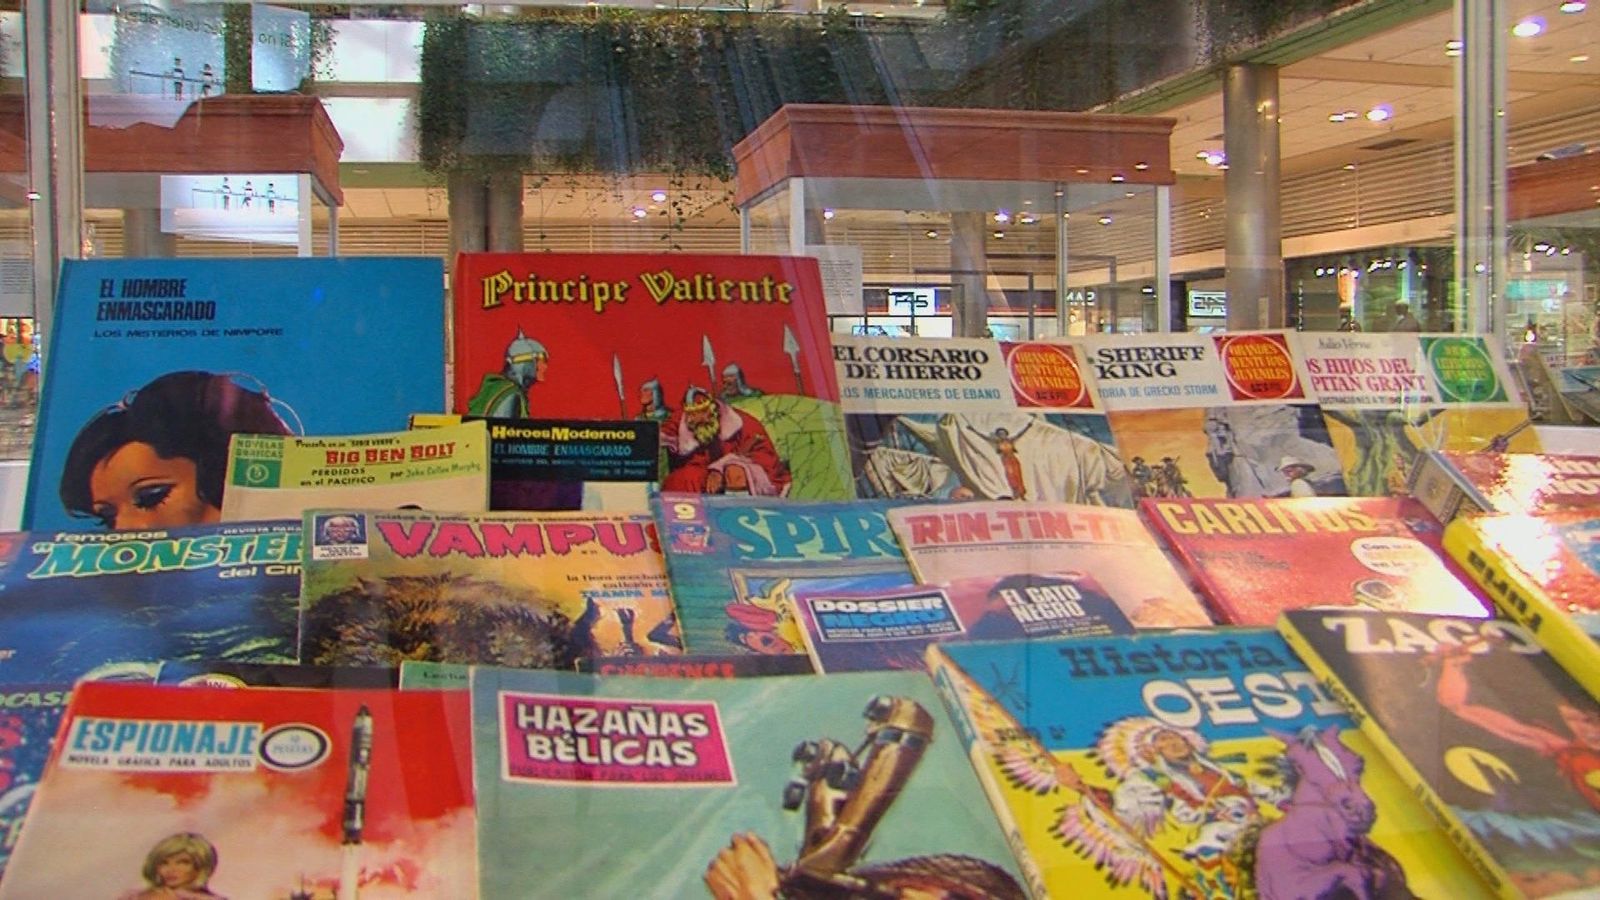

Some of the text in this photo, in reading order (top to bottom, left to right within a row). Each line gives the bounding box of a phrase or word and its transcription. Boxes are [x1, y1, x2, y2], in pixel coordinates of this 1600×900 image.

[100, 278, 188, 298] EL HOMBRE
[481, 270, 631, 313] Principe
[640, 269, 794, 305] Valiente
[96, 301, 217, 321] ENMASCARADO
[94, 330, 121, 338] LOS
[126, 329, 198, 338] MISTERIOS
[201, 329, 221, 338] DE
[833, 345, 989, 364] EL CORSARIO
[1097, 346, 1205, 364] SHERIFF
[845, 364, 983, 381] DE HIERRO
[1095, 362, 1177, 379] KING
[1323, 358, 1377, 375] HIJOS
[1380, 358, 1415, 374] DEL
[1128, 387, 1141, 397] DE
[1183, 384, 1218, 395] STORM
[1366, 375, 1426, 391] GRANT
[863, 388, 941, 400] MERCADERES
[944, 388, 961, 400] DE
[963, 388, 1001, 400] EBANO
[551, 426, 636, 441] Modernos
[325, 441, 457, 464] BIG BEN BOLT
[554, 444, 632, 457] ENMASCARADO
[311, 467, 366, 476] PERDIDOS
[300, 476, 376, 487] en el PACIFICO
[673, 502, 696, 519] 9
[1156, 500, 1376, 535] CARLITOS
[54, 530, 169, 543] famosos
[218, 566, 258, 578] del
[999, 584, 1082, 606] EL GATO
[813, 597, 944, 613] DOSSIER
[1009, 601, 1086, 623] NEGRO
[820, 609, 946, 627] NEGRO
[1059, 640, 1285, 677] Historia
[517, 702, 710, 738] HAZAÑAS
[72, 719, 260, 755] ESPIONAJE
[67, 755, 109, 765] NOVELA
[169, 758, 197, 767] PARA
[204, 758, 252, 768] ADULTOS
